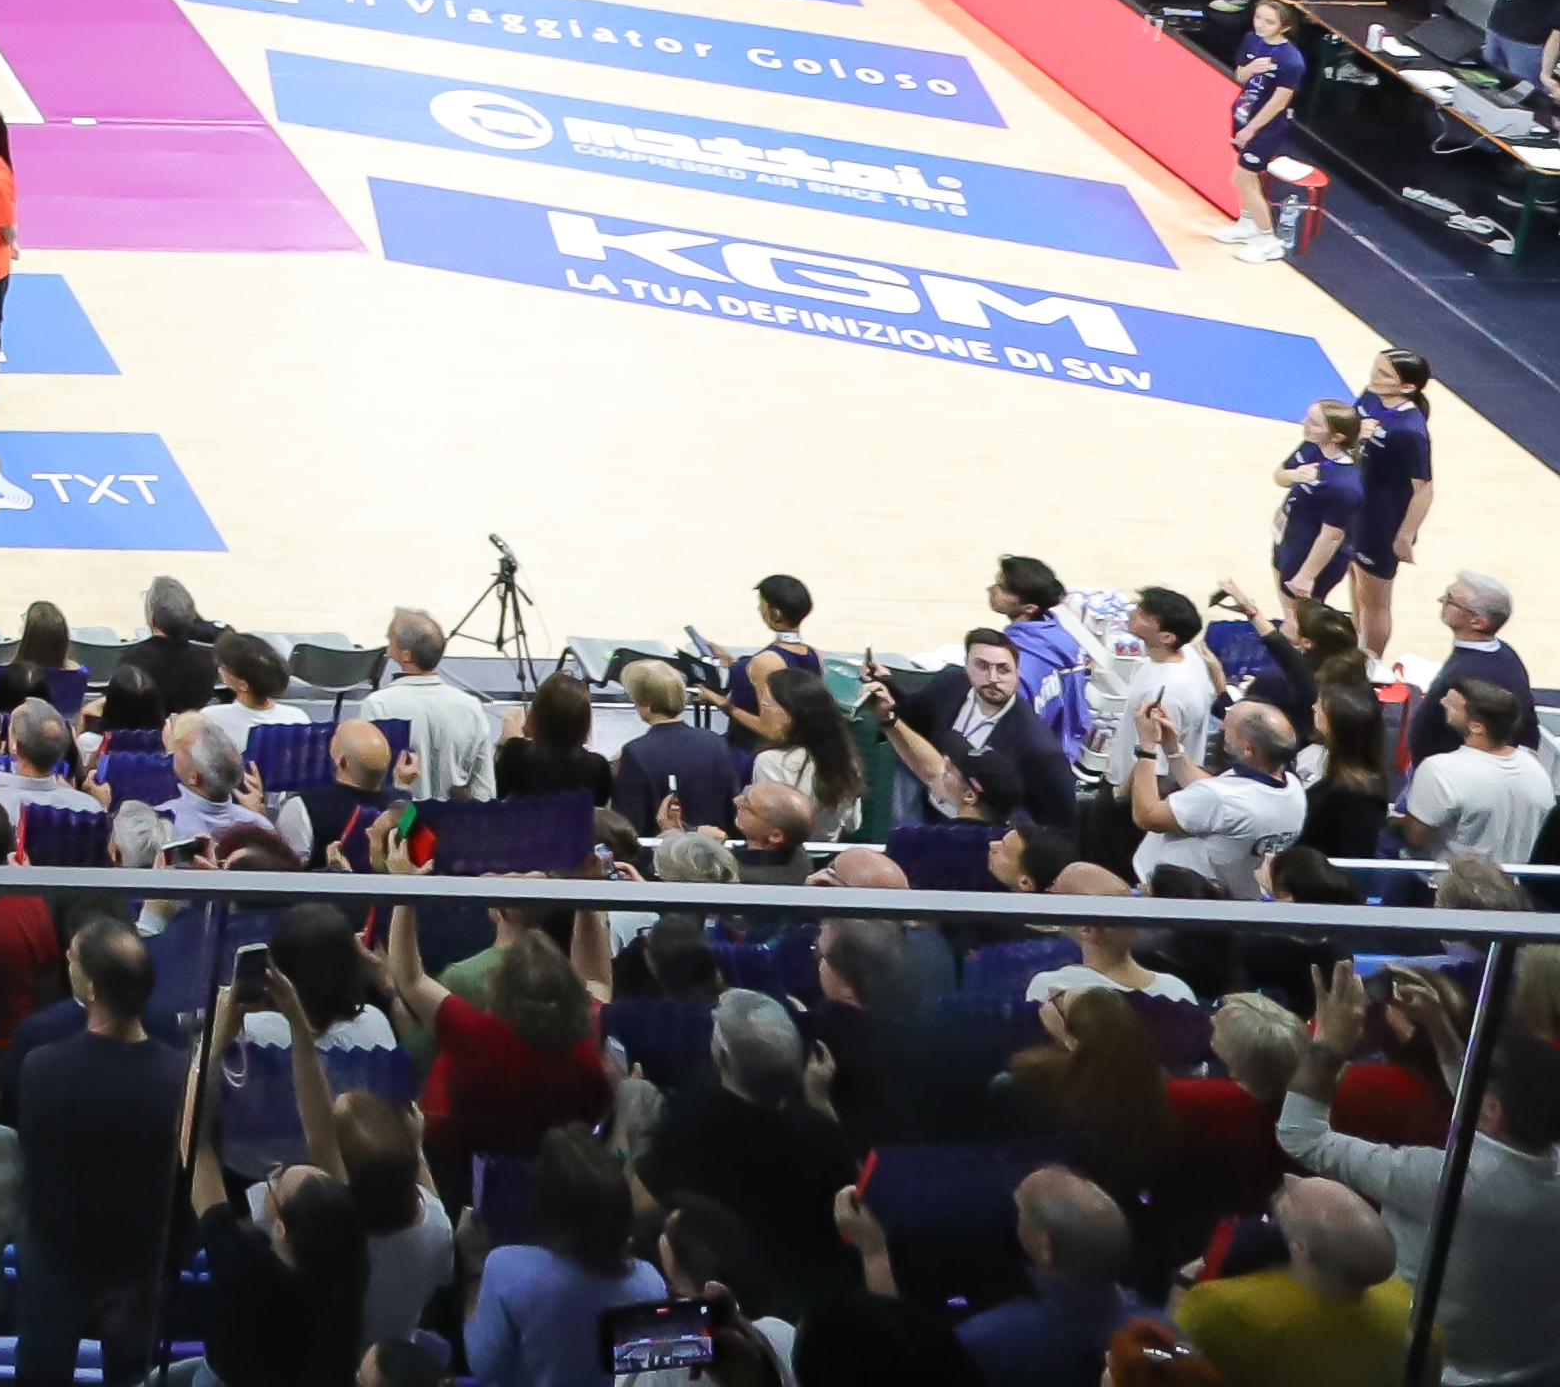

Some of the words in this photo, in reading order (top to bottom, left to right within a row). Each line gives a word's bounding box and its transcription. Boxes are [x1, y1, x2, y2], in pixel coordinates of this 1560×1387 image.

[746, 45, 959, 96] Goloso
[572, 141, 747, 182] COMPRESSED
[755, 172, 800, 191] AIR
[807, 179, 887, 204] SINCE
[546, 210, 1139, 357] KGM
[564, 267, 619, 298] LA
[623, 277, 712, 312] TUA
[719, 294, 999, 367] DEFINIZIONE
[1004, 342, 1055, 375] DI
[1060, 357, 1154, 393] SUV
[31, 473, 161, 506] TXT
